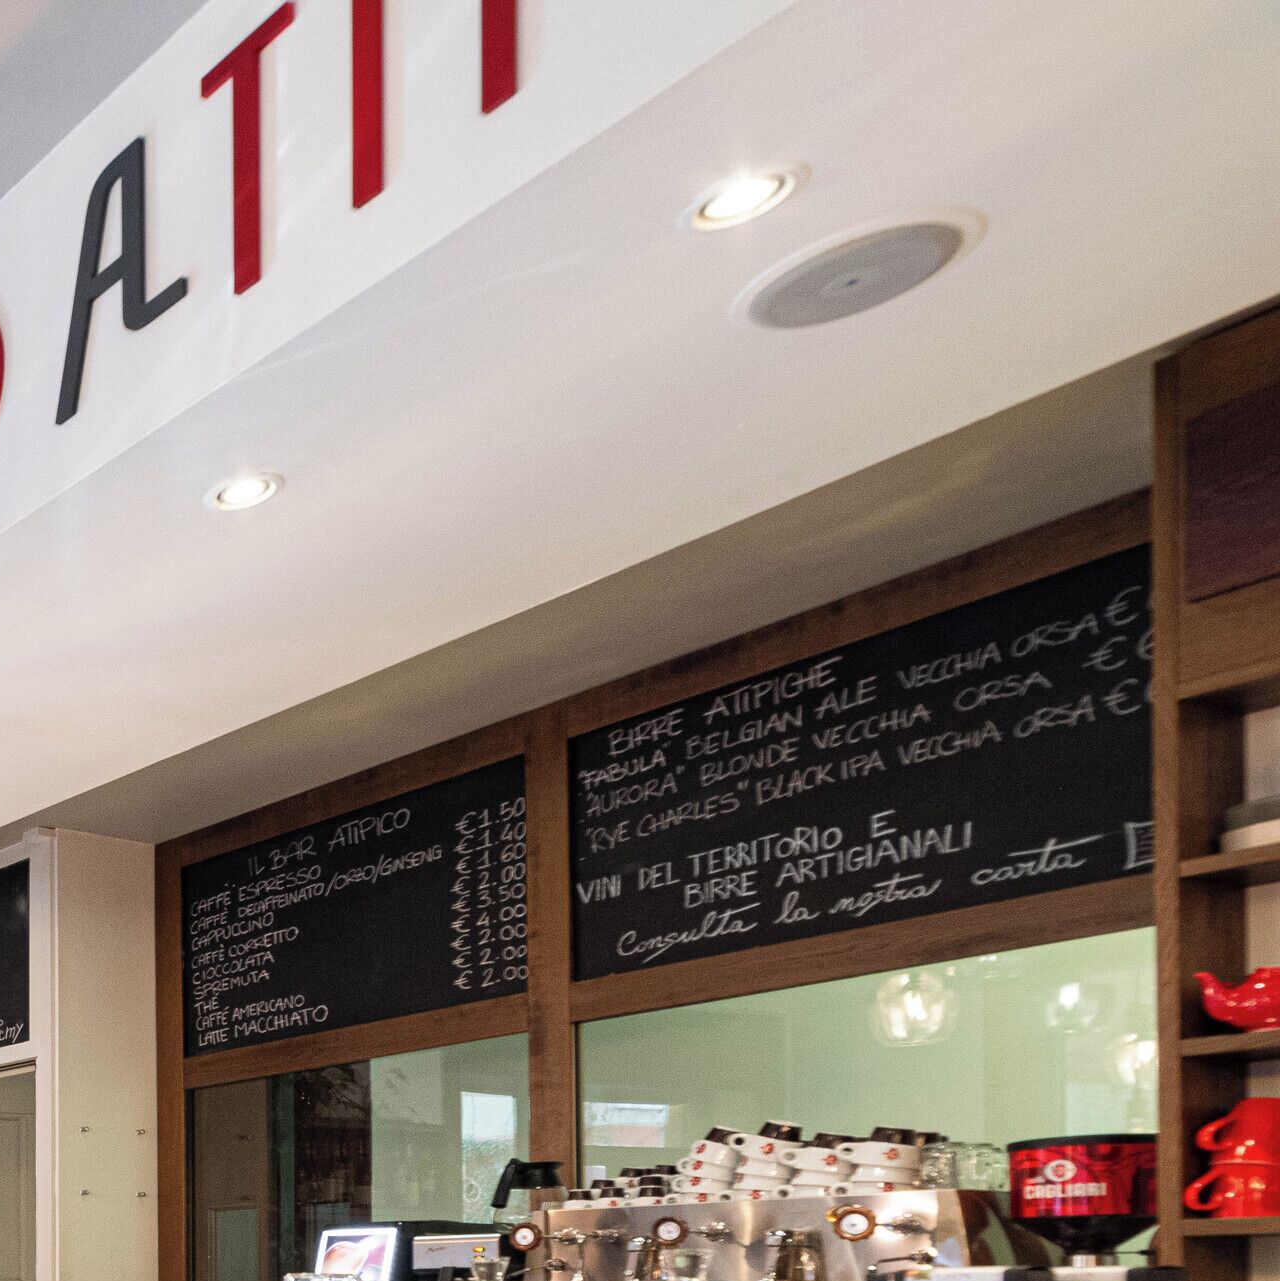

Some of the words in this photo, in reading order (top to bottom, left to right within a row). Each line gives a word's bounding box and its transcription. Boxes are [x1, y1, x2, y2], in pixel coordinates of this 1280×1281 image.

[686, 705, 803, 760] BELGIAN
[816, 675, 877, 721] ALE
[1011, 612, 1100, 659] ORSA
[608, 708, 684, 757] BIRRE
[699, 738, 800, 788] BLONDE
[811, 703, 931, 750] VECCHIA
[952, 671, 1053, 712] ORSA
[755, 761, 835, 806] BLACK
[841, 749, 886, 782] IPA
[1012, 694, 1096, 739] ORSA
[248, 855, 265, 877] IL
[269, 835, 317, 871] BAR
[329, 808, 411, 851] ATIPICO
[577, 873, 622, 905] VINI
[639, 862, 681, 892] DEL
[688, 825, 844, 878] TERRITORIO
[871, 809, 898, 839] E
[684, 871, 759, 910] BIRRE
[775, 821, 973, 888] ARTIGIANALI
[239, 865, 322, 903] ESPRESSO
[616, 902, 761, 964] Consulta
[774, 891, 824, 926] la
[827, 873, 942, 918] nostra
[970, 833, 1108, 886] carta
[191, 912, 274, 951] CAPPUCCINO
[228, 926, 299, 957] CORRETTO
[192, 951, 275, 985] CIOCCOLATA
[193, 969, 270, 1000] SPREMUTA
[199, 1027, 230, 1047] LATTE
[234, 1004, 329, 1038] MACCHIATO
[232, 994, 306, 1022] AMERICANO
